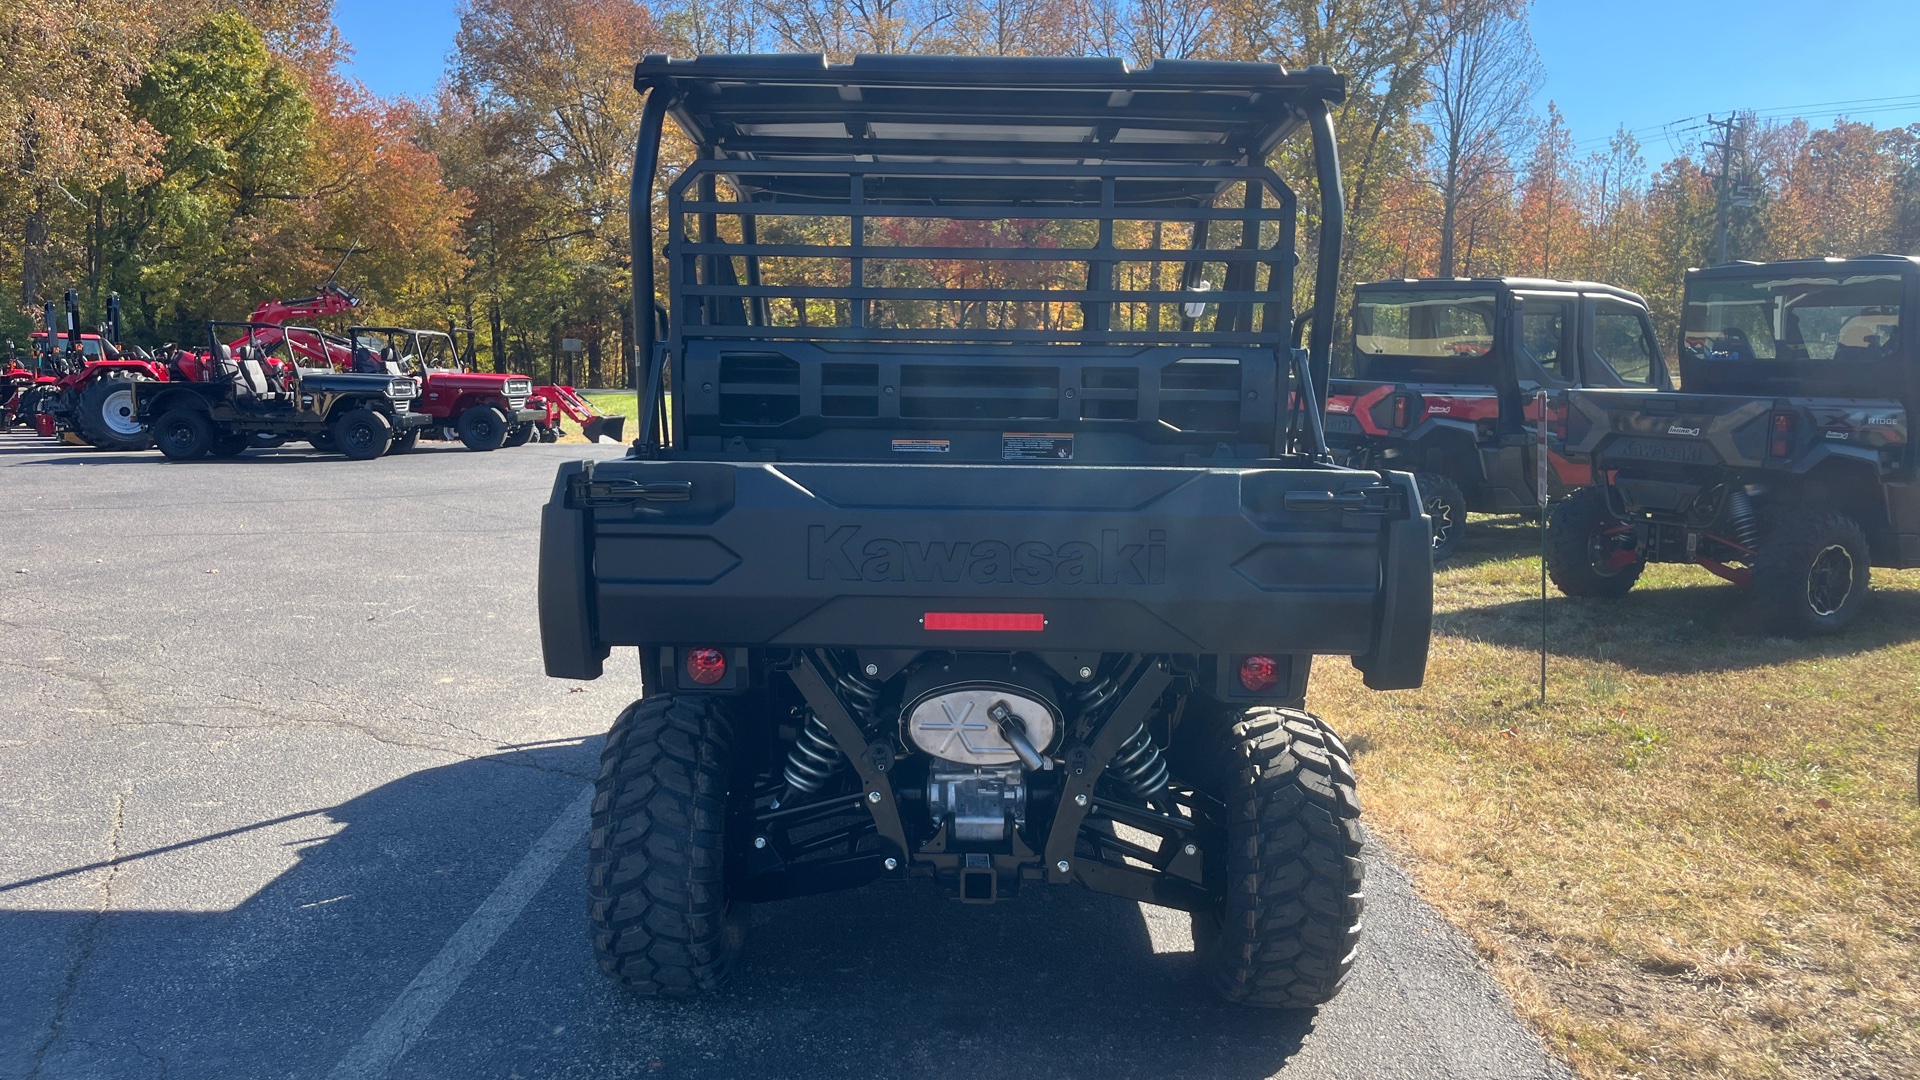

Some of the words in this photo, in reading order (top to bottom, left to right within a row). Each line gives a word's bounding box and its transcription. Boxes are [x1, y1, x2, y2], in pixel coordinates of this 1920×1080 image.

[1669, 426, 1699, 436] Inline-4
[1620, 440, 1702, 462] Kawasaki
[807, 524, 1167, 585] Kawasaki
